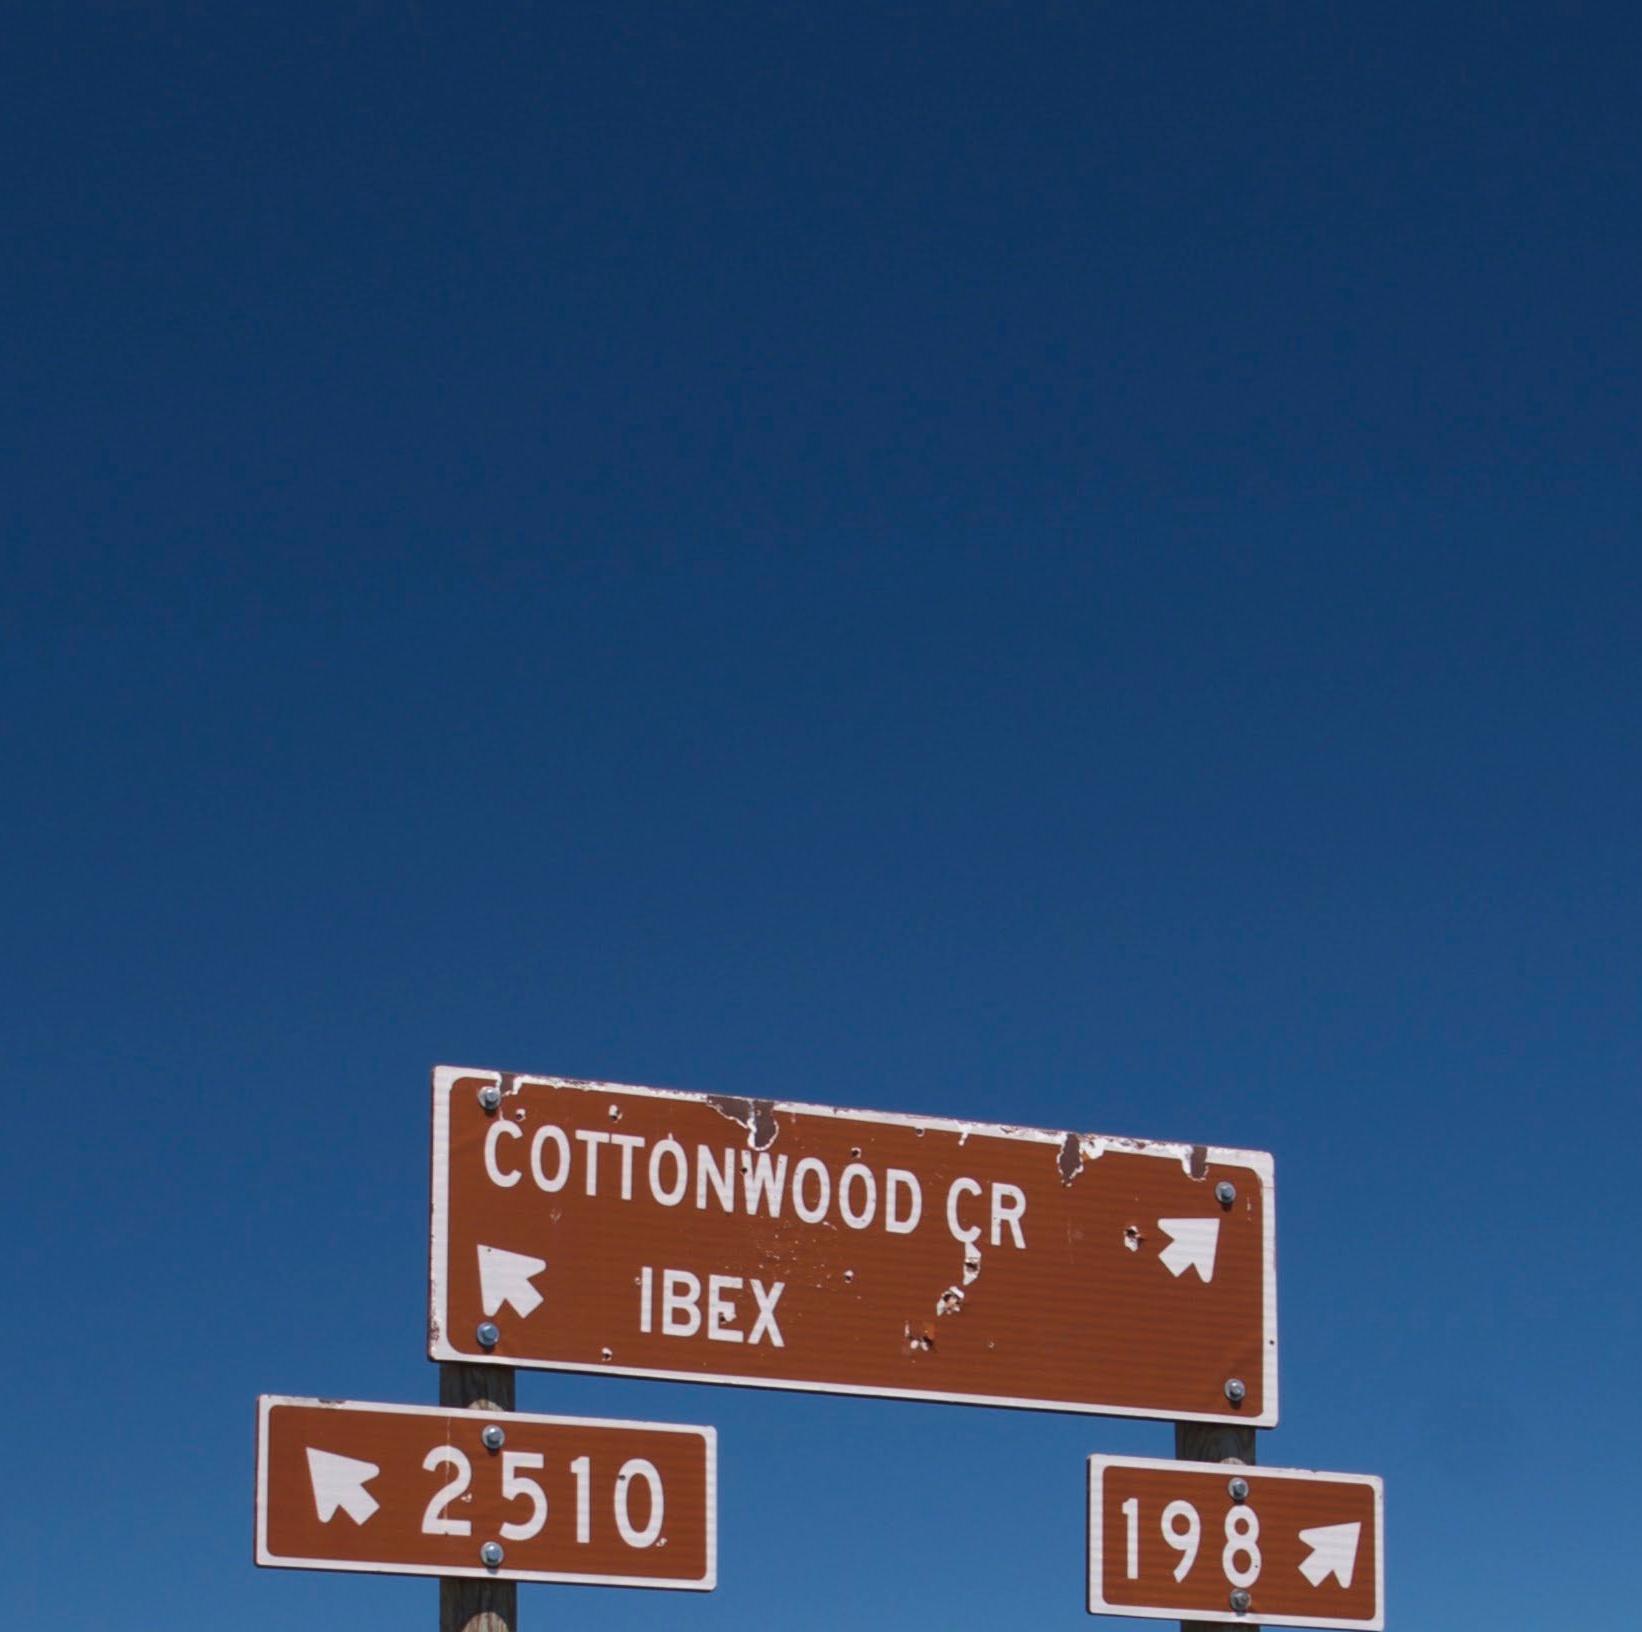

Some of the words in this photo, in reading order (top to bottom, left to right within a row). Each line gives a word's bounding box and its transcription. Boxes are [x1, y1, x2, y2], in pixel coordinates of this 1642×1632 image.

[483, 1118, 924, 1236] COTTONWOOD
[946, 1176, 1027, 1250] CR
[639, 1265, 787, 1348] IBEX
[420, 1443, 665, 1549] 2510
[1121, 1497, 1262, 1589] 198
